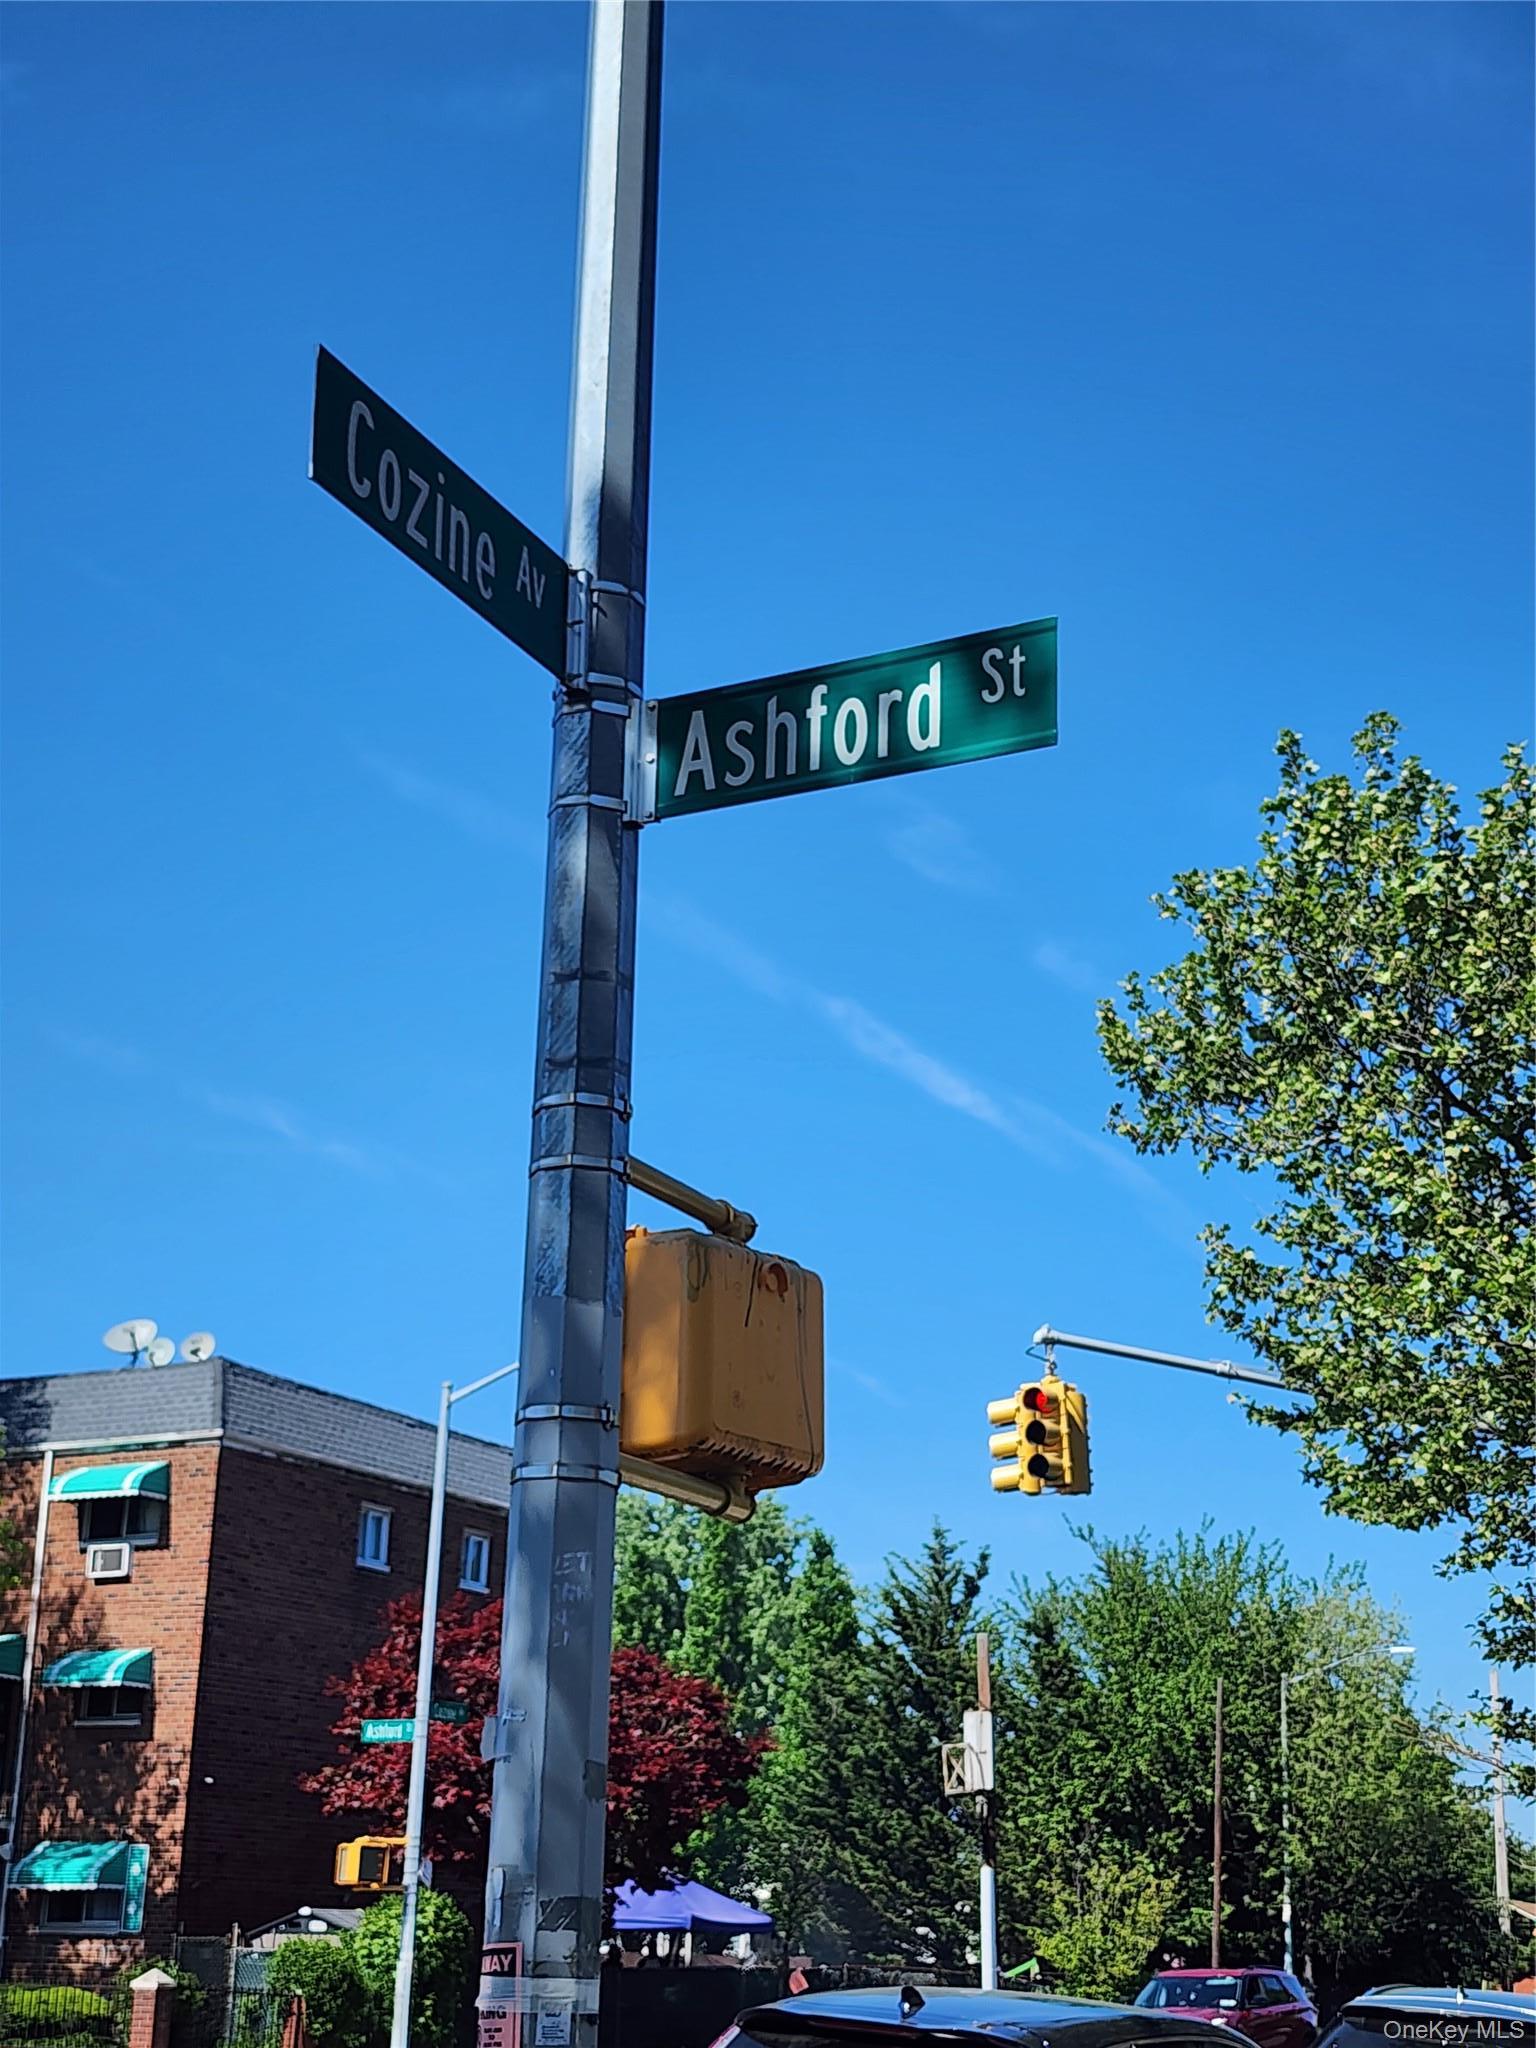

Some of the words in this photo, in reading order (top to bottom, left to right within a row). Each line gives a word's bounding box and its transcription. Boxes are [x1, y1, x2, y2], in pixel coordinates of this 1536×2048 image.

[347, 400, 496, 601] Cozine
[516, 545, 547, 608] Av
[673, 661, 942, 797] Ashford
[981, 645, 1026, 704] St
[365, 1723, 402, 1739] Ashford
